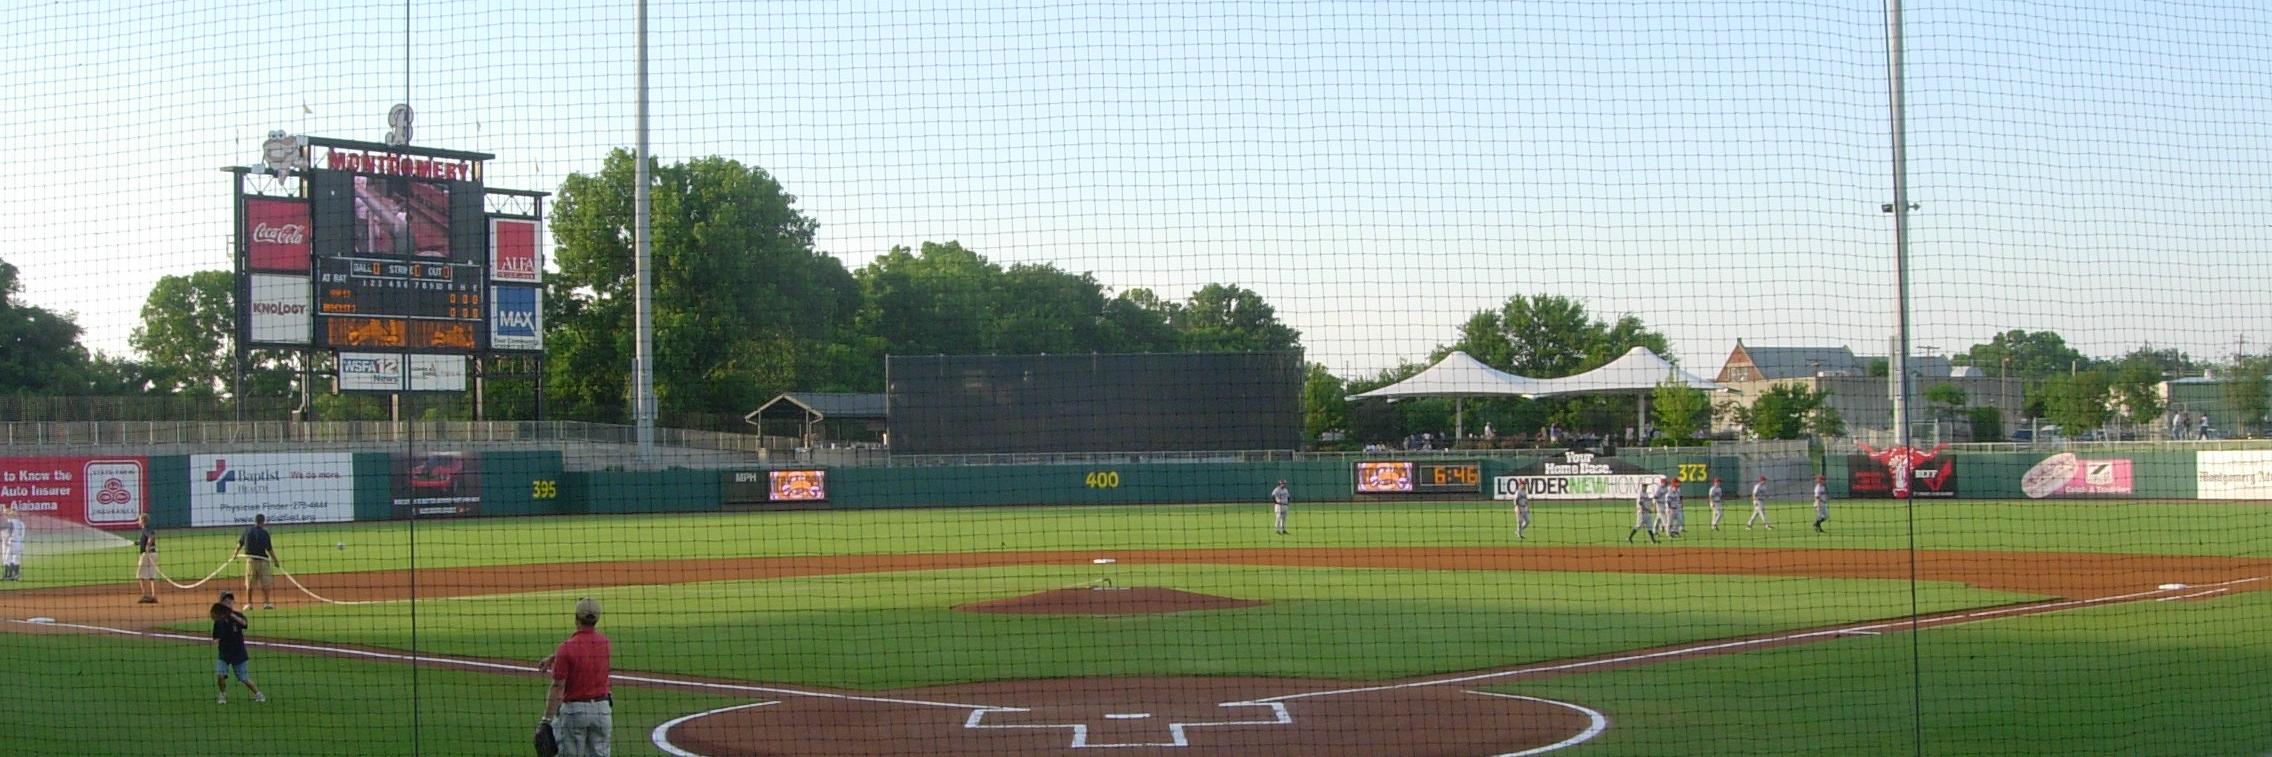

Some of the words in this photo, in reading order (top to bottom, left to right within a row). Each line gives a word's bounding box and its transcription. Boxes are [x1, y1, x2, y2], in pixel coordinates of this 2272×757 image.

[327, 149, 469, 181] MONTGOMERY
[501, 256, 534, 272] ALFA
[333, 274, 347, 284] BAT
[253, 301, 306, 315] KNOLOGY
[500, 310, 535, 335] MAX
[343, 358, 377, 374] WSFA
[376, 358, 398, 375] 12
[1565, 451, 1594, 464] Your
[4, 471, 16, 481] to
[20, 470, 49, 481] Know
[54, 470, 72, 481] the
[238, 469, 279, 484] Baptist
[1434, 464, 1478, 487] 6:46
[1545, 463, 1578, 475] Home
[1678, 464, 1707, 482] 373
[736, 473, 756, 483] MPH
[1086, 471, 1119, 488] 400
[1, 486, 28, 497] Auto
[32, 485, 71, 496] Insurer
[532, 480, 557, 498] 395
[10, 501, 58, 511] Alabama
